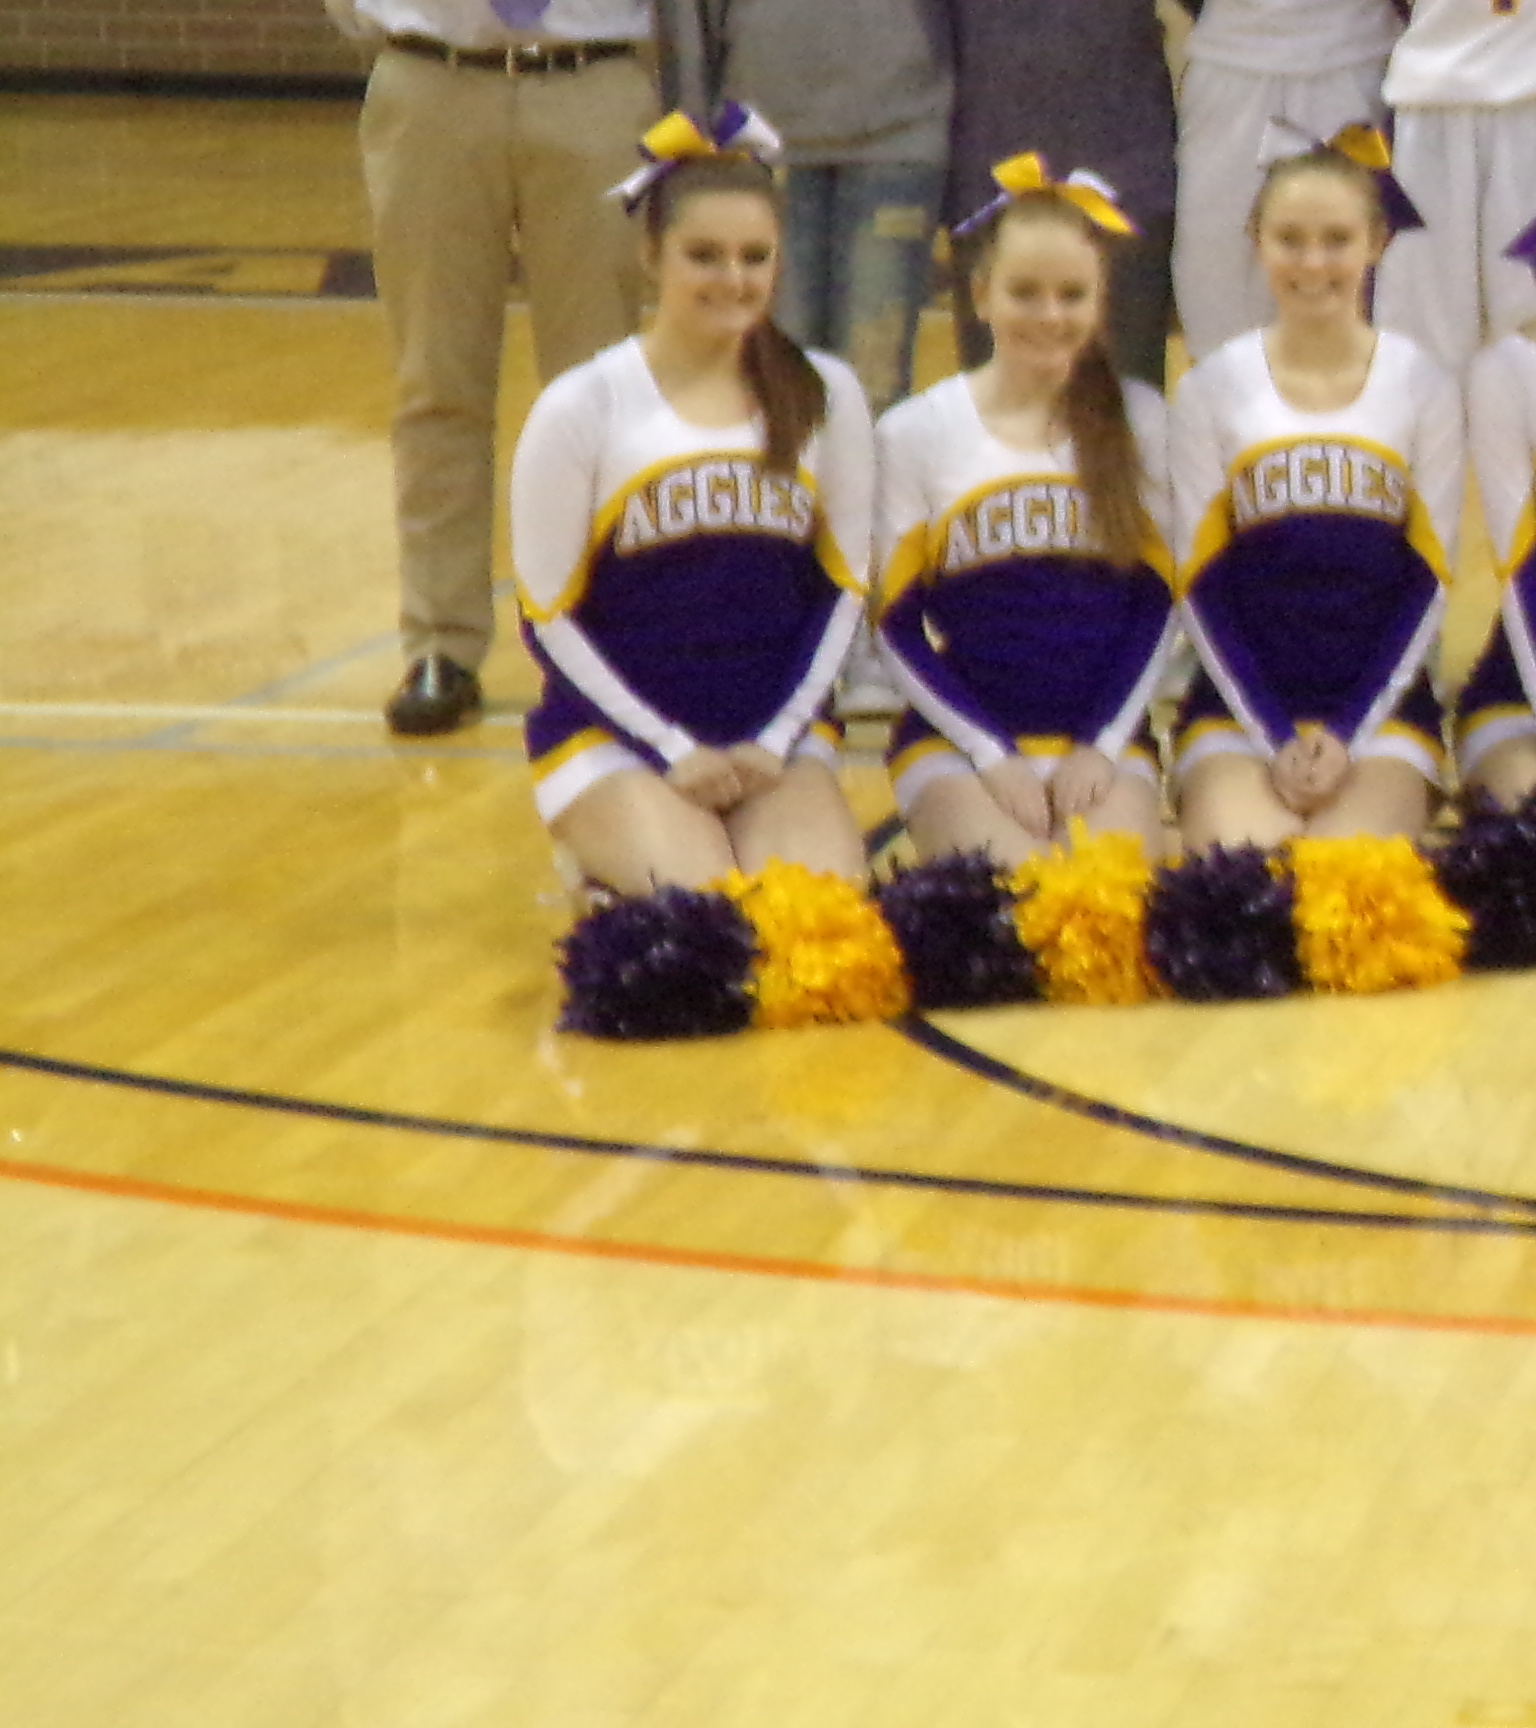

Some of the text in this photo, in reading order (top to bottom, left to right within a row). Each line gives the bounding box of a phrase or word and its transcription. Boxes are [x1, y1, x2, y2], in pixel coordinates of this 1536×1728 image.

[618, 460, 814, 553] AGGIES
[943, 482, 1094, 572] AGGI
[1232, 444, 1406, 530] AGGIES
